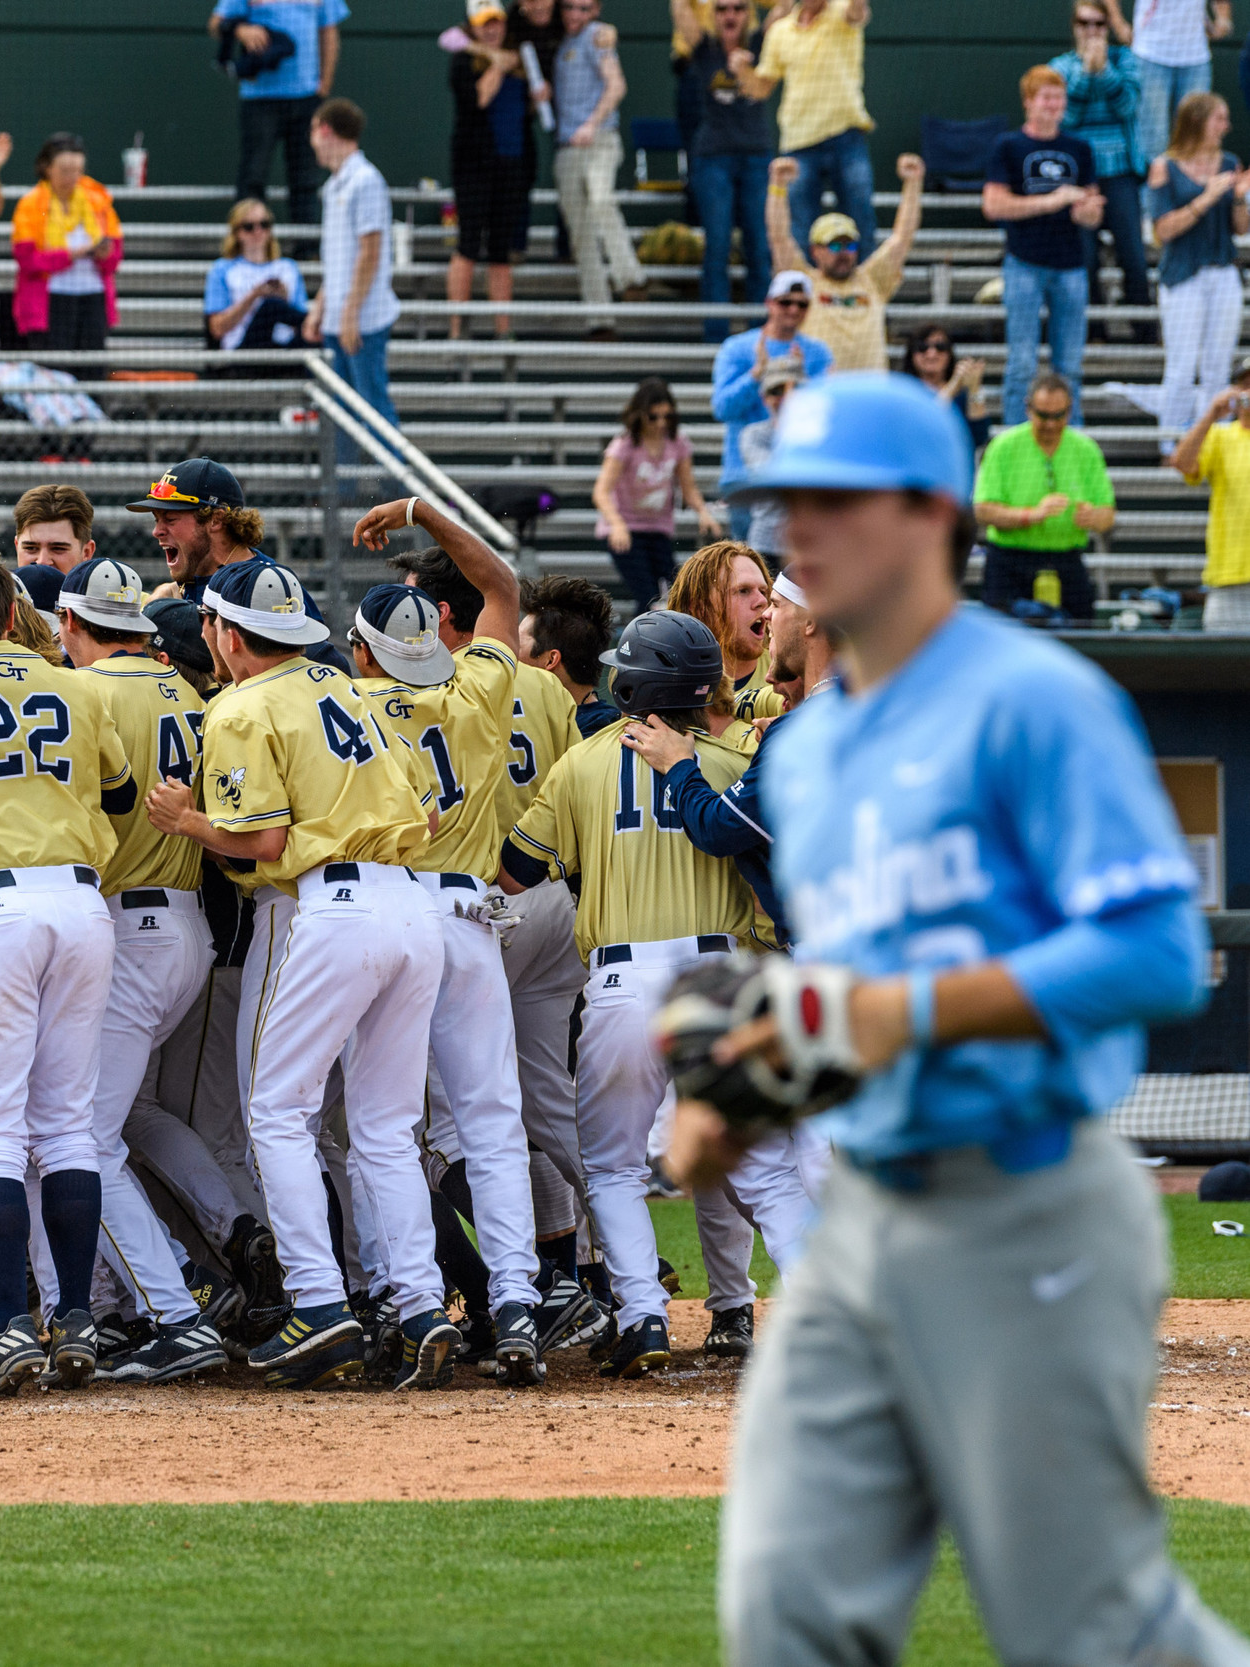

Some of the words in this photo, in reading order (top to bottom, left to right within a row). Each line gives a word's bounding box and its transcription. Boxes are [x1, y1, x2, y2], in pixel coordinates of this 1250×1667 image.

[307, 665, 338, 683] GT
[158, 683, 180, 702] GT
[385, 698, 414, 719] GT
[316, 692, 390, 768] 4
[397, 724, 464, 815] 1
